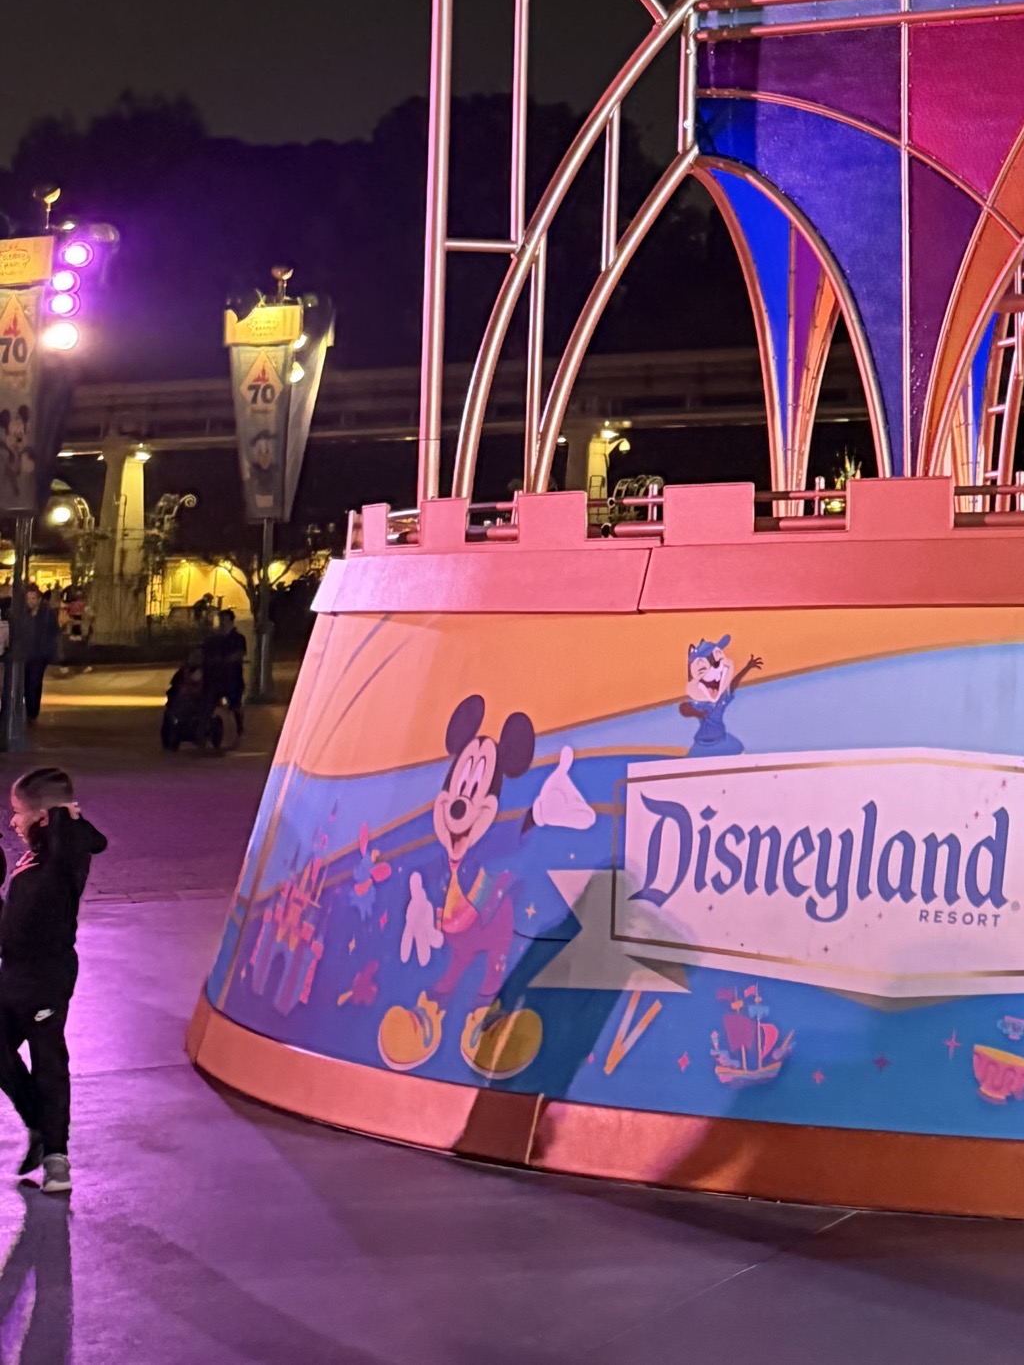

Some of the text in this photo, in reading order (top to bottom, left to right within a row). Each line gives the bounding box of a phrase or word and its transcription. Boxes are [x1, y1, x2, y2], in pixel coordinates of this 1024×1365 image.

[247, 384, 275, 405] 70
[627, 790, 1010, 923] Disneyland
[919, 909, 1001, 928] RESORT
